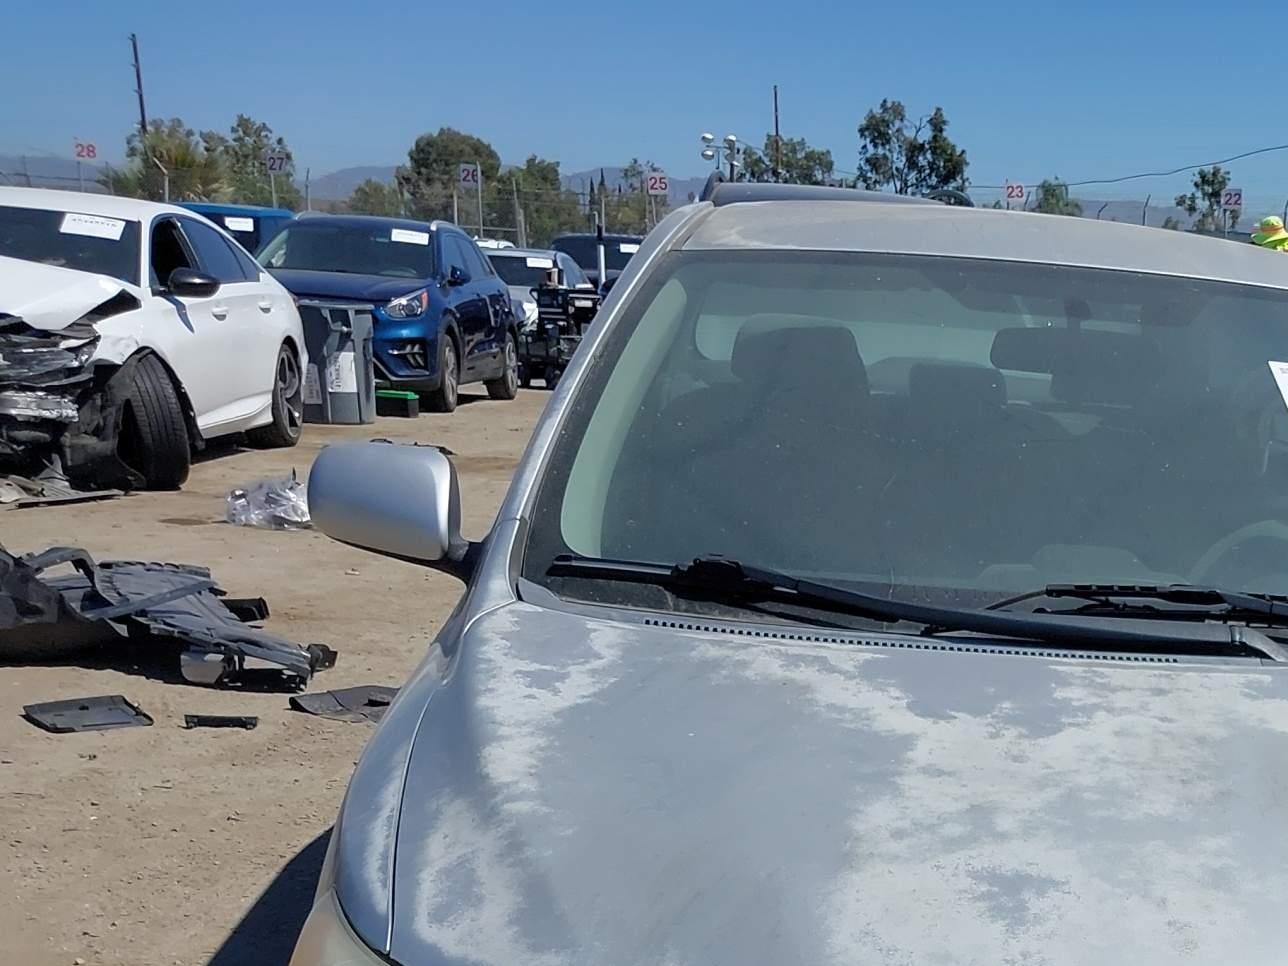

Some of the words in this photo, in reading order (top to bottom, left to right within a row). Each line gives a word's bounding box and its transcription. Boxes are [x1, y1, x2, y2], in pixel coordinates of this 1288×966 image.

[75, 143, 97, 159] 28
[267, 156, 285, 171] 27
[648, 176, 669, 192] 25
[1006, 185, 1025, 199] 23
[1223, 192, 1242, 206] 22
